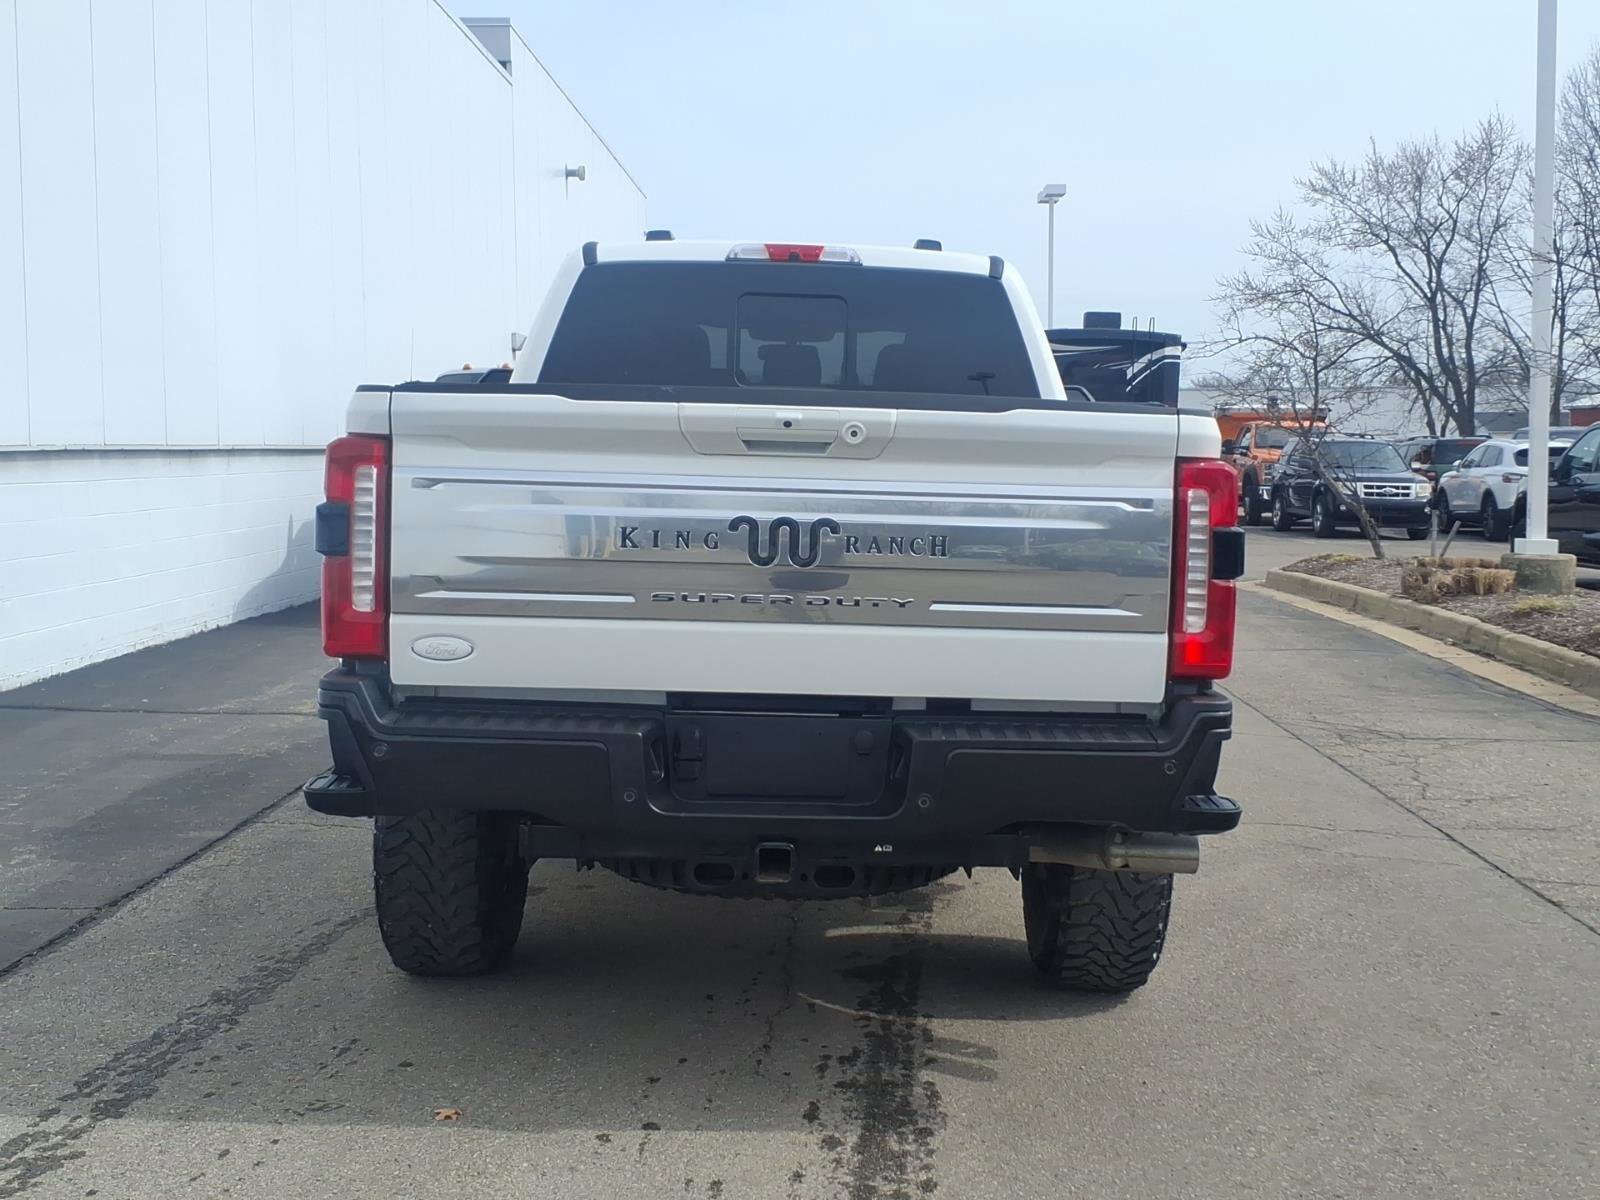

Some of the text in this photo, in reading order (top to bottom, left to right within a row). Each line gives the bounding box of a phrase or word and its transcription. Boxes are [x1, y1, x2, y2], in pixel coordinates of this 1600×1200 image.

[619, 525, 720, 551] KING
[844, 534, 949, 558] RANCH
[650, 591, 914, 609] SUPER DUTY
[424, 640, 459, 657] Ford
